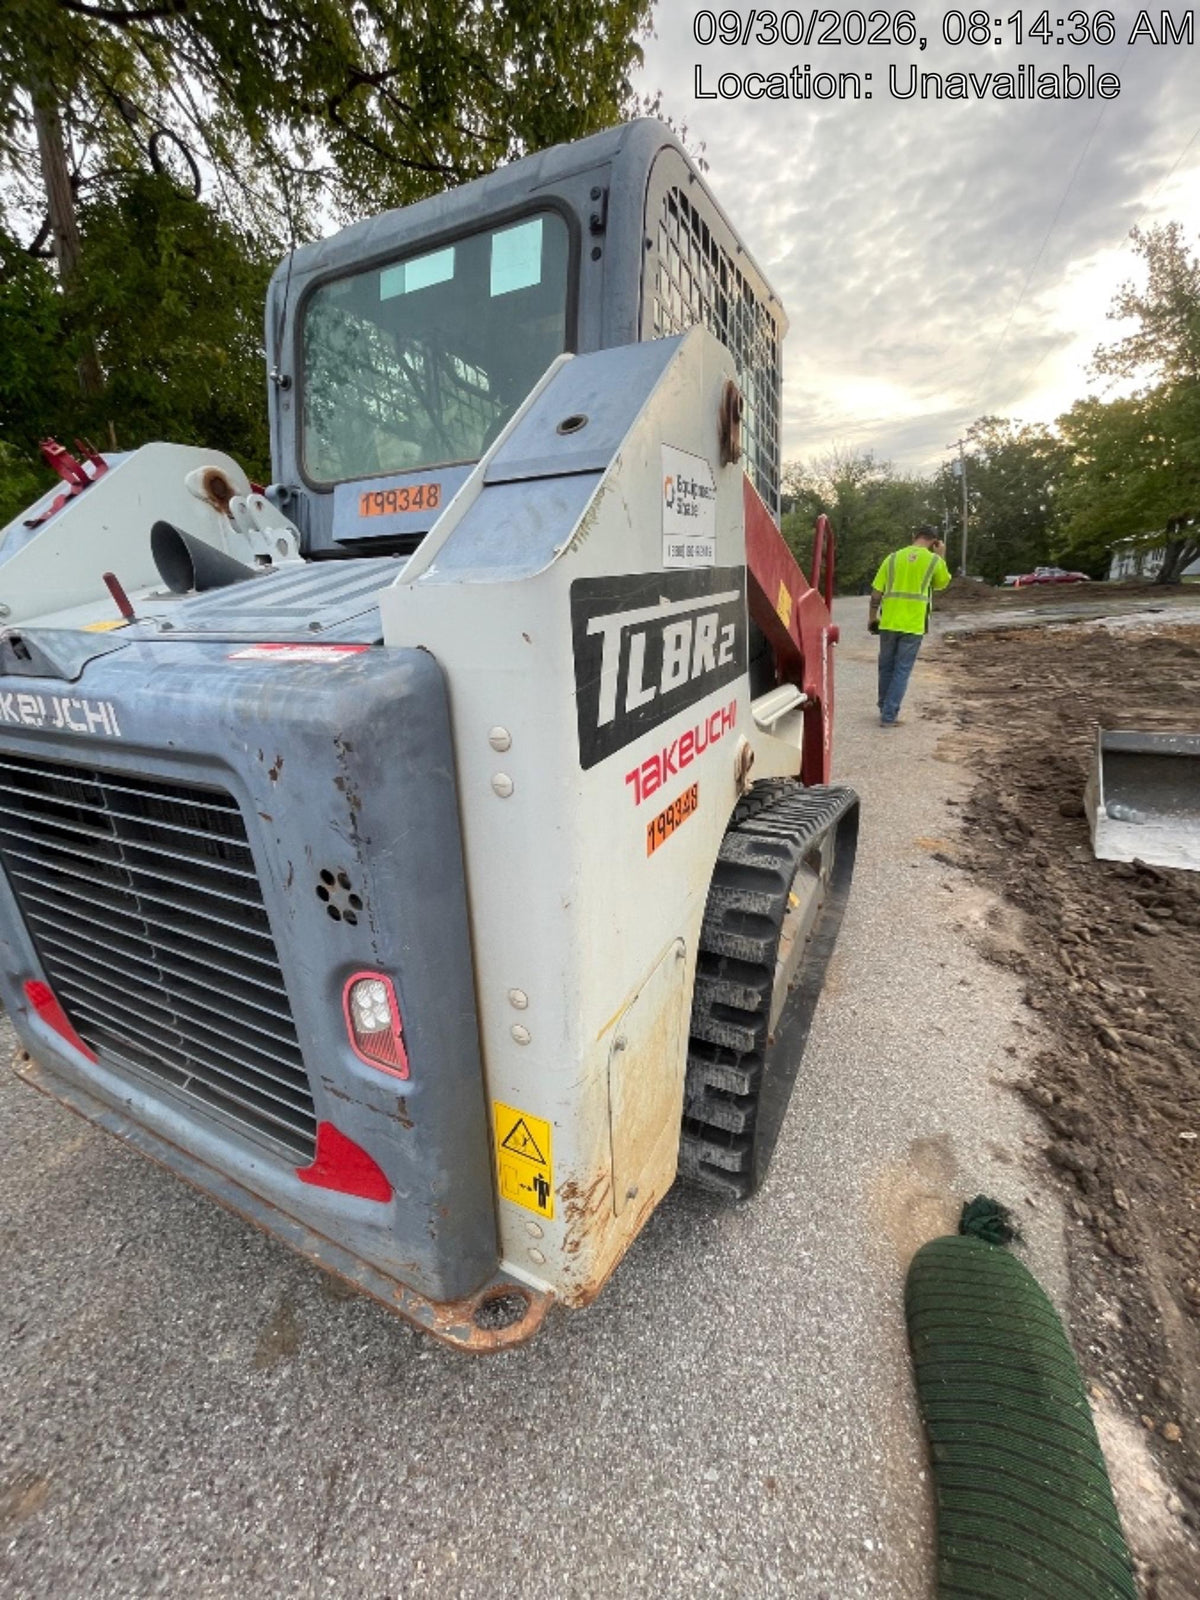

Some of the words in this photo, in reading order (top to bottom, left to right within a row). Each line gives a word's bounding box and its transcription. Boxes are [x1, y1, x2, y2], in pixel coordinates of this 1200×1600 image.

[361, 484, 439, 514] 199348
[676, 474, 717, 500] Equipme
[647, 783, 698, 851] 199348
